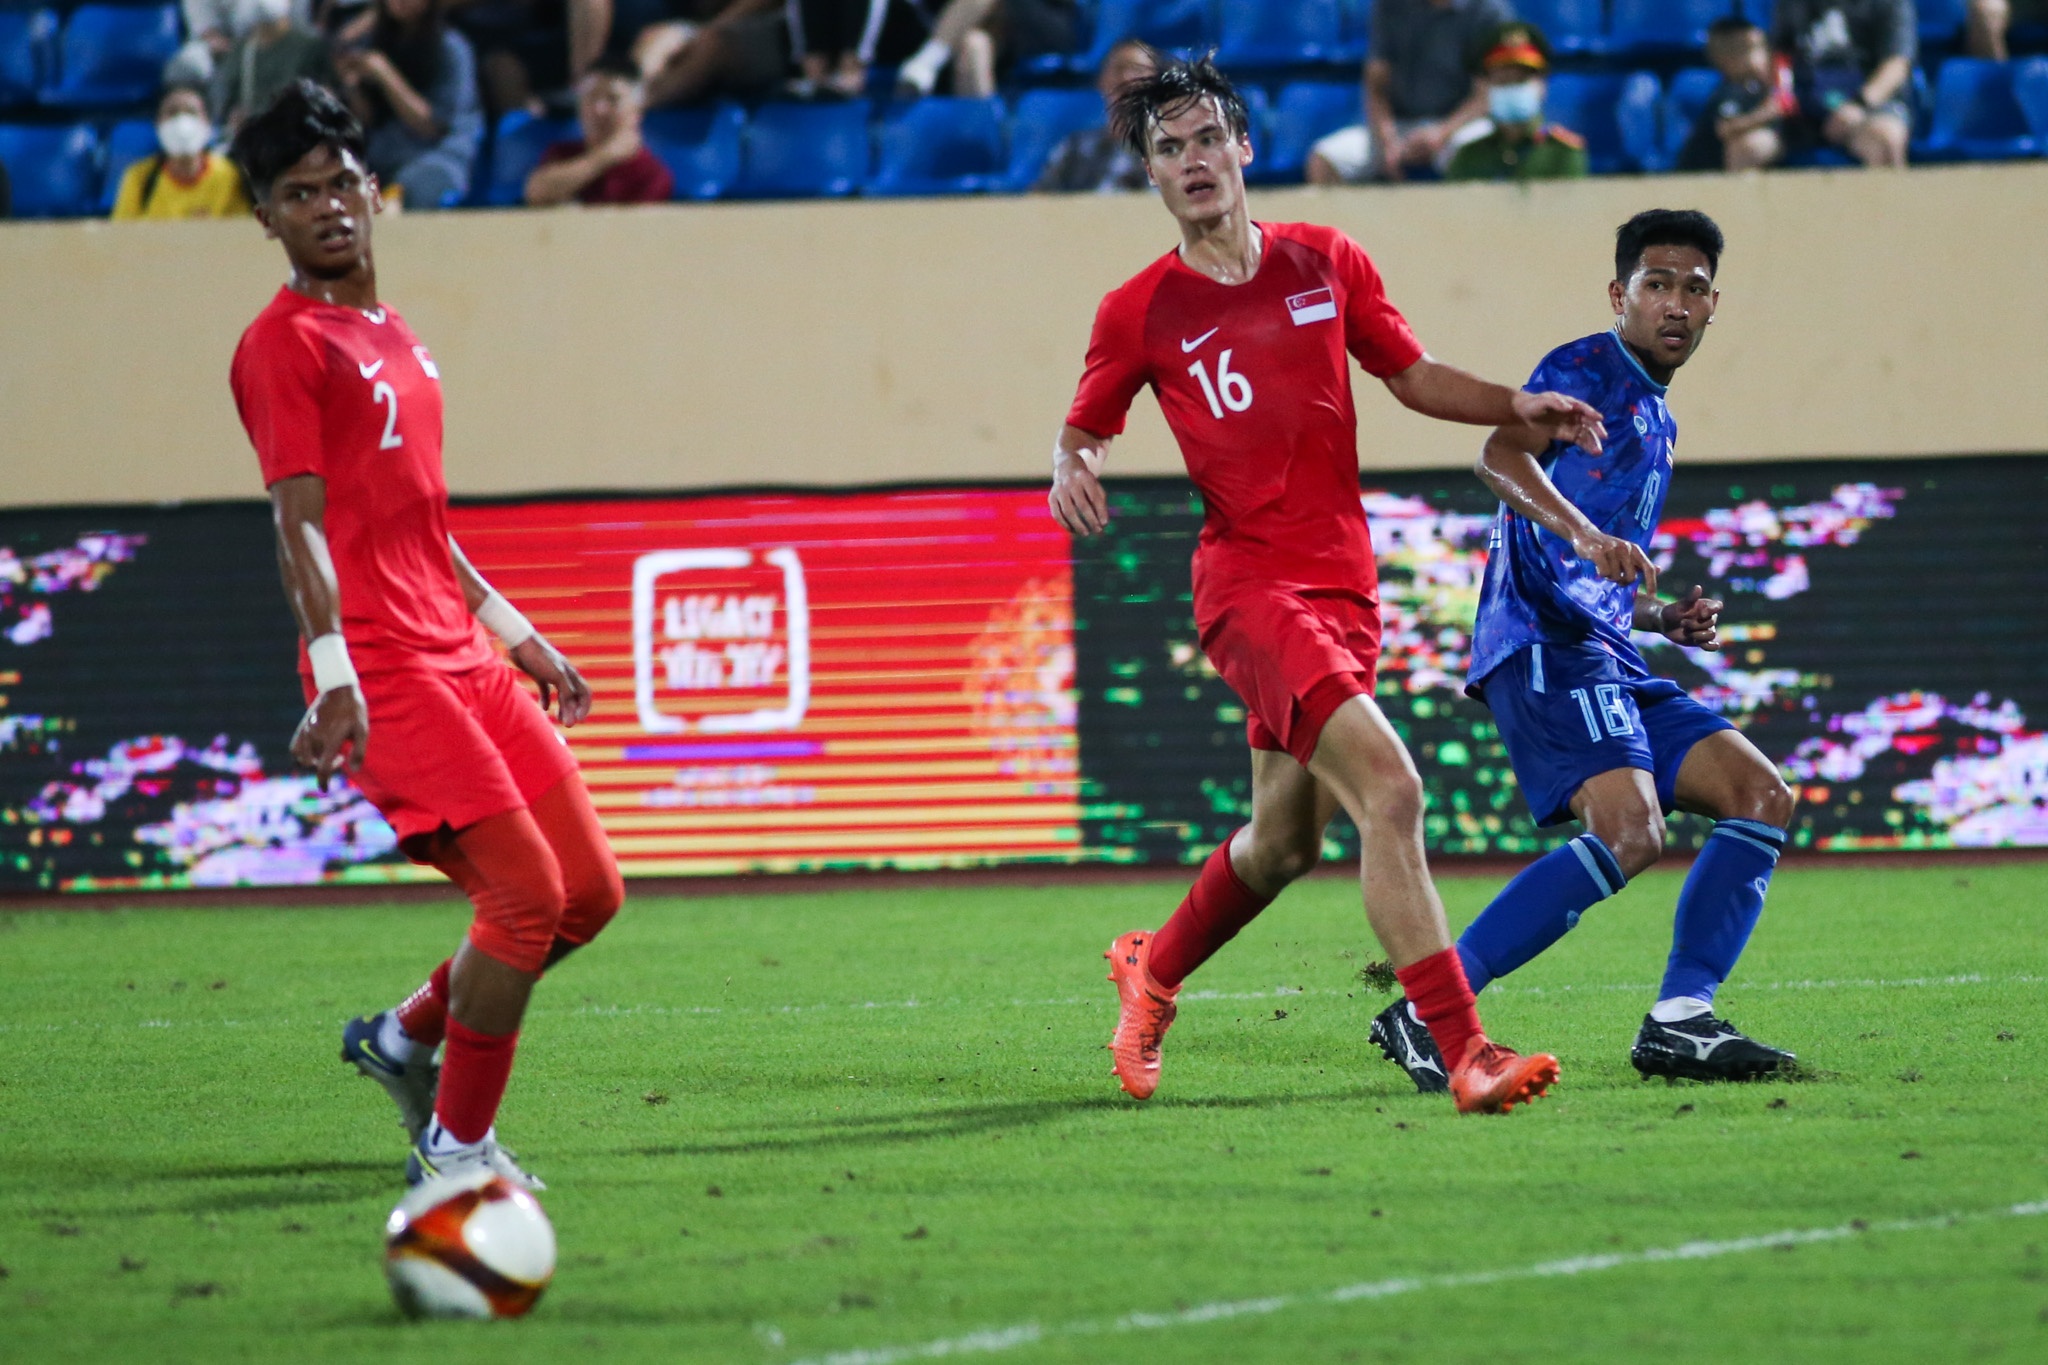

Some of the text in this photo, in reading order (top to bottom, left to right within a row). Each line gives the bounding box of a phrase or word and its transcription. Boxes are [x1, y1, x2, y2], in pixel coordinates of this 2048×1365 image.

[373, 381, 403, 450] 2
[1188, 349, 1253, 419] 16
[1634, 469, 1661, 530] 18
[1570, 682, 1634, 743] 18
